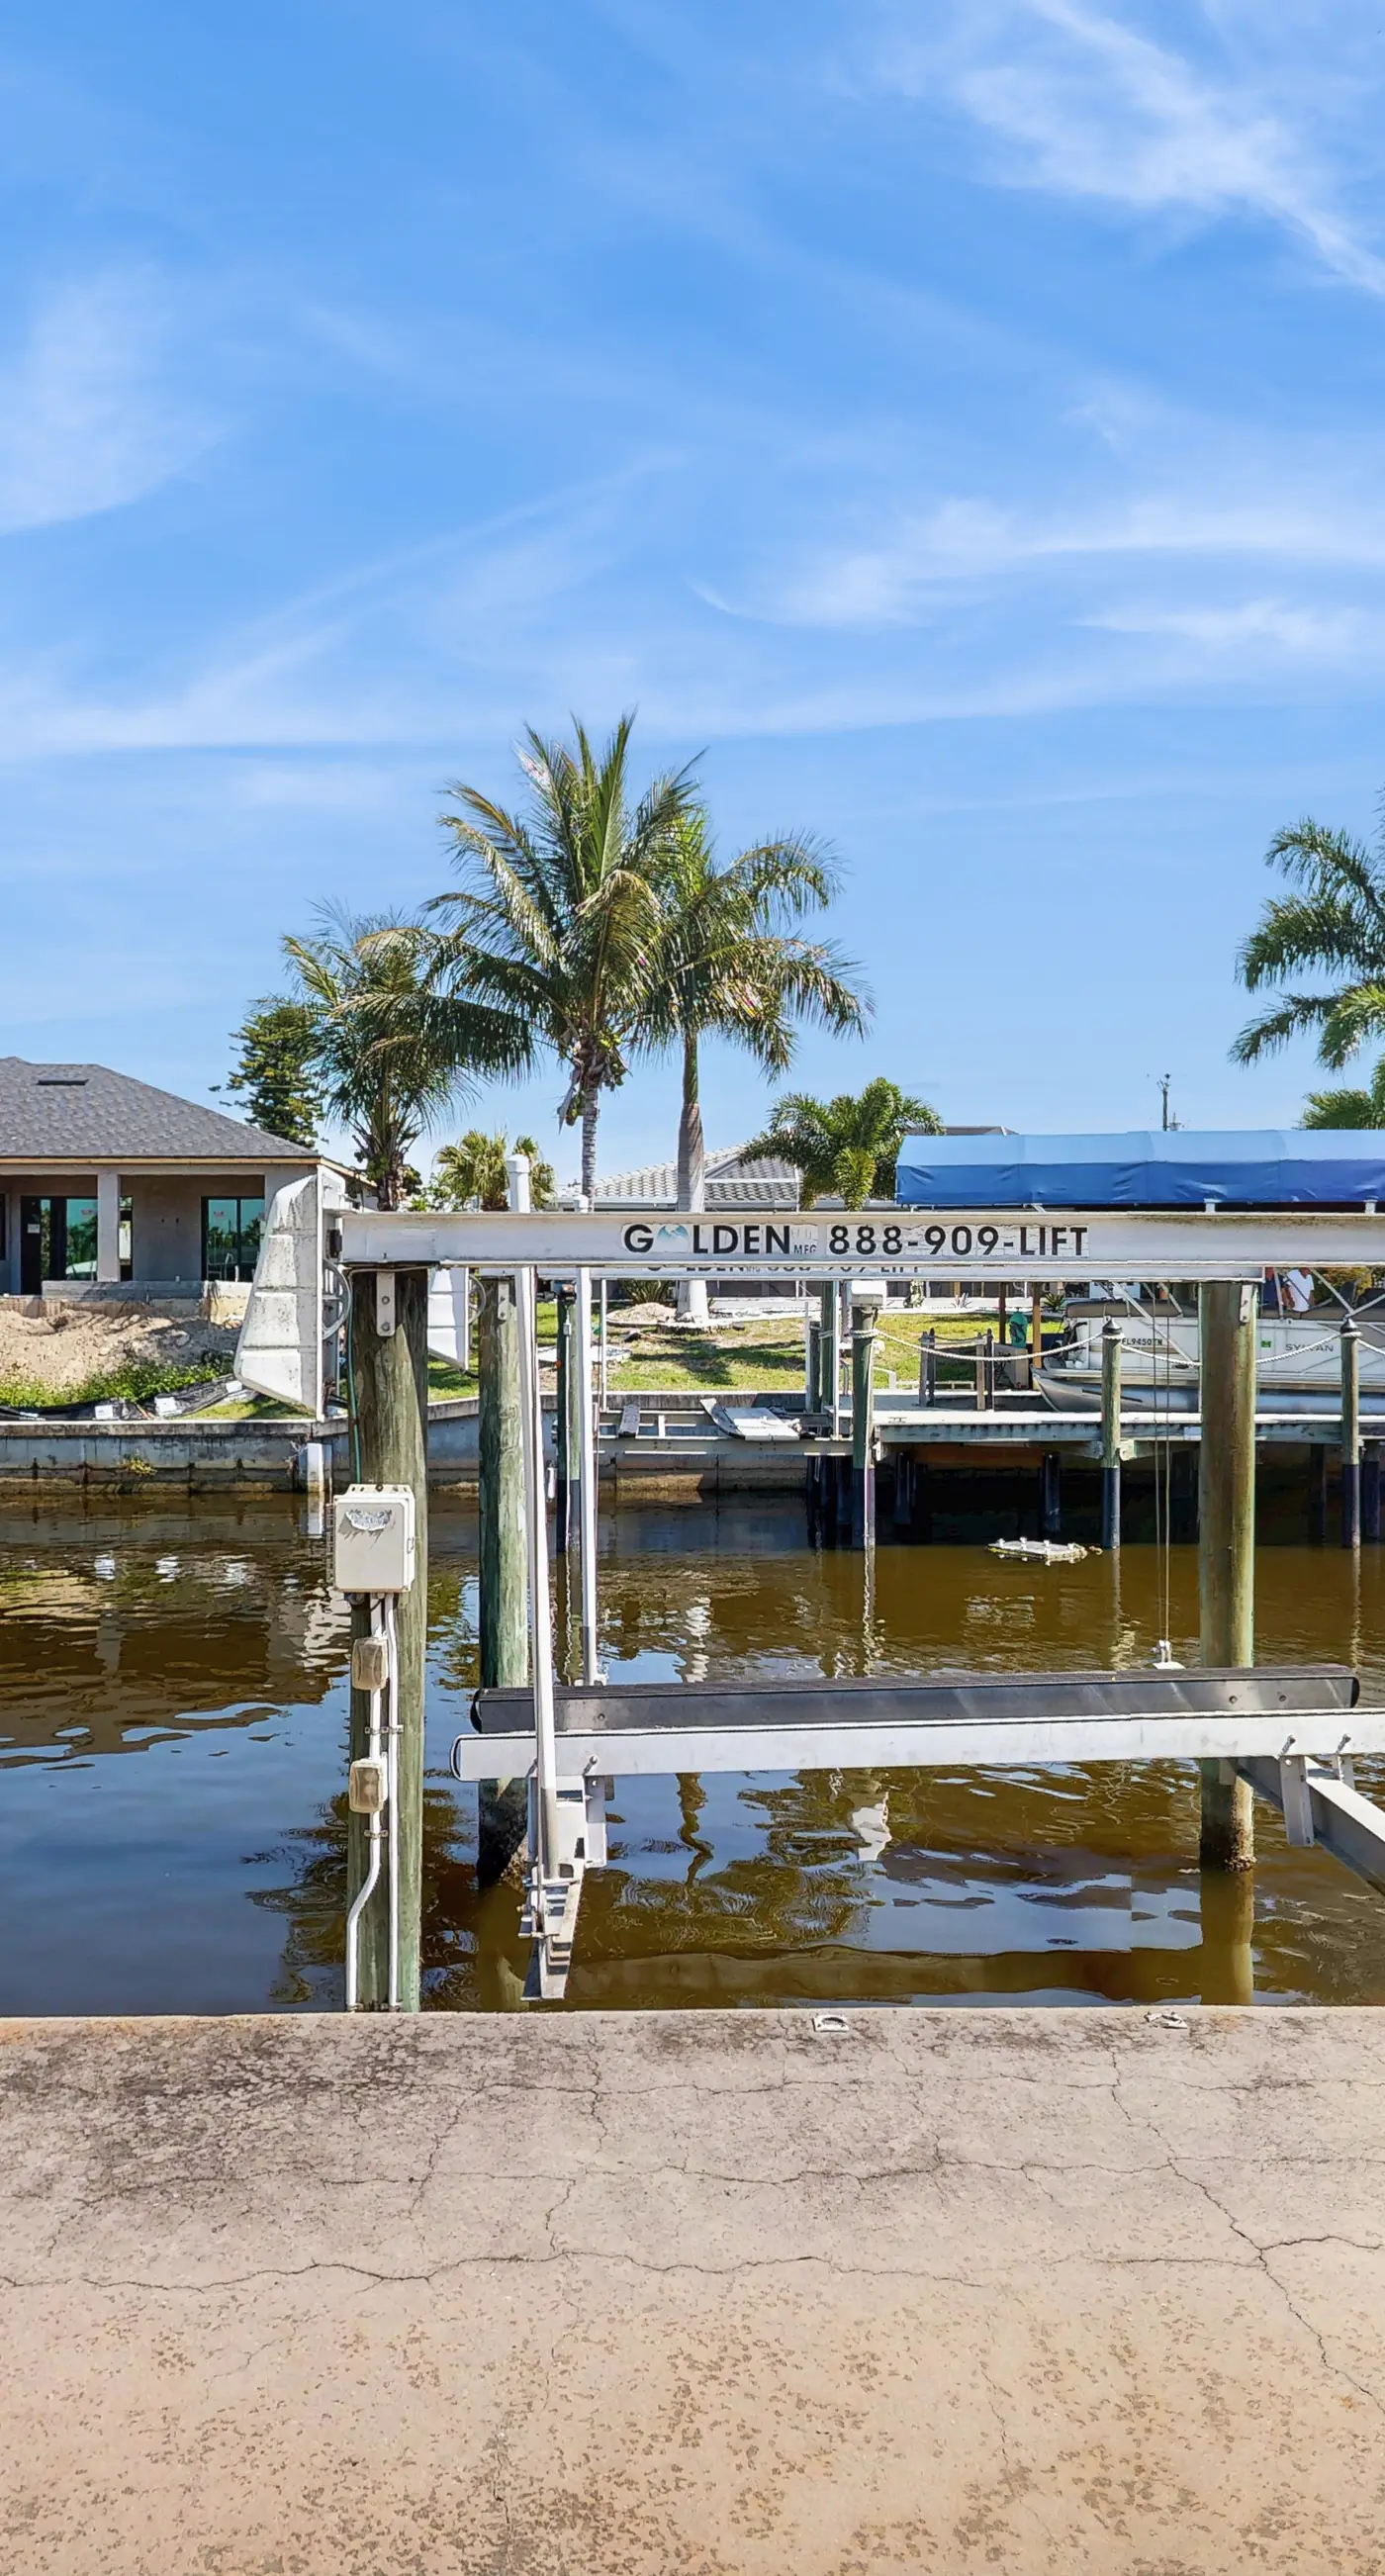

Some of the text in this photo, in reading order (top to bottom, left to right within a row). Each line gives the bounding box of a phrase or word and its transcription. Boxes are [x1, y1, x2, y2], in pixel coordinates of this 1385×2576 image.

[793, 1244, 817, 1254] MFG
[829, 1225, 1088, 1255] 888-909-LIFT
[1285, 1342, 1335, 1353] SYVAN
